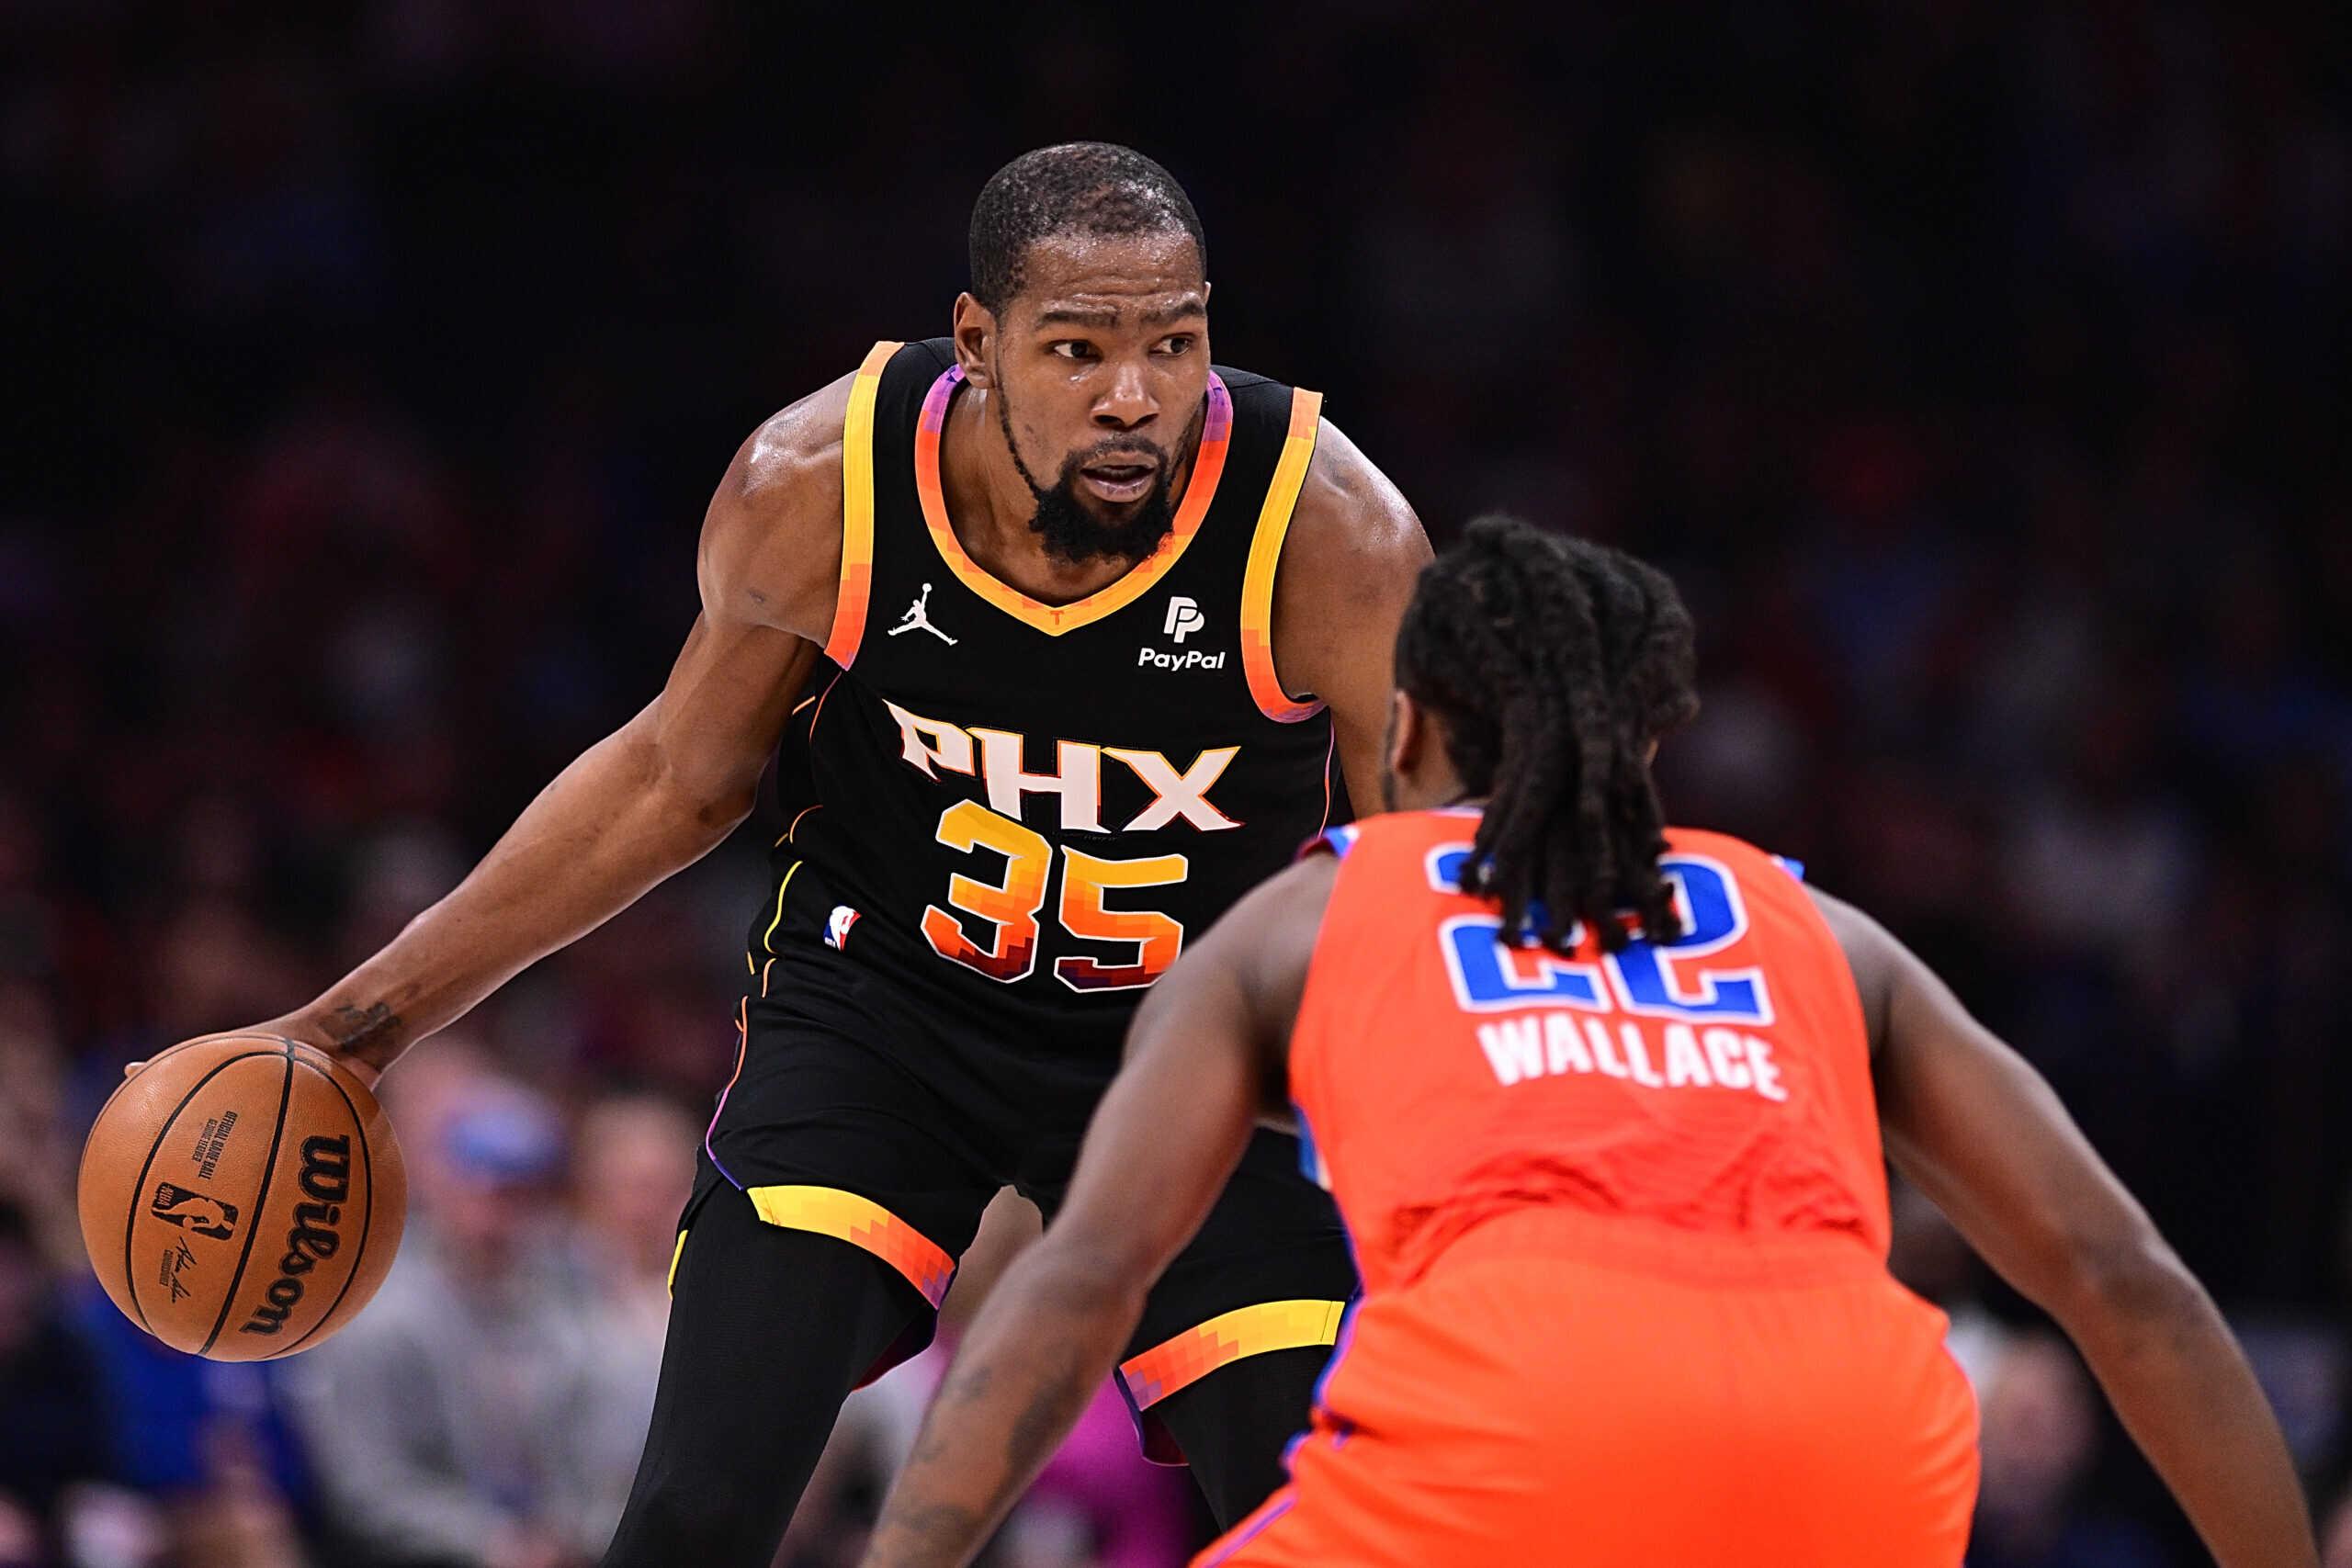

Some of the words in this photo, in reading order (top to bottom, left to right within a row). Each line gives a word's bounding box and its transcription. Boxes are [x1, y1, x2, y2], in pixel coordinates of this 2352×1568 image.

[1137, 647, 1226, 671] PayPal
[882, 698, 1246, 834] PHX
[921, 798, 1189, 993] 35
[1425, 841, 1775, 1027] 22
[1476, 1011, 1788, 1101] WALLACE
[156, 1186, 175, 1207] NBA
[198, 1160, 216, 1179] BALL
[239, 1134, 351, 1336] Wilson
